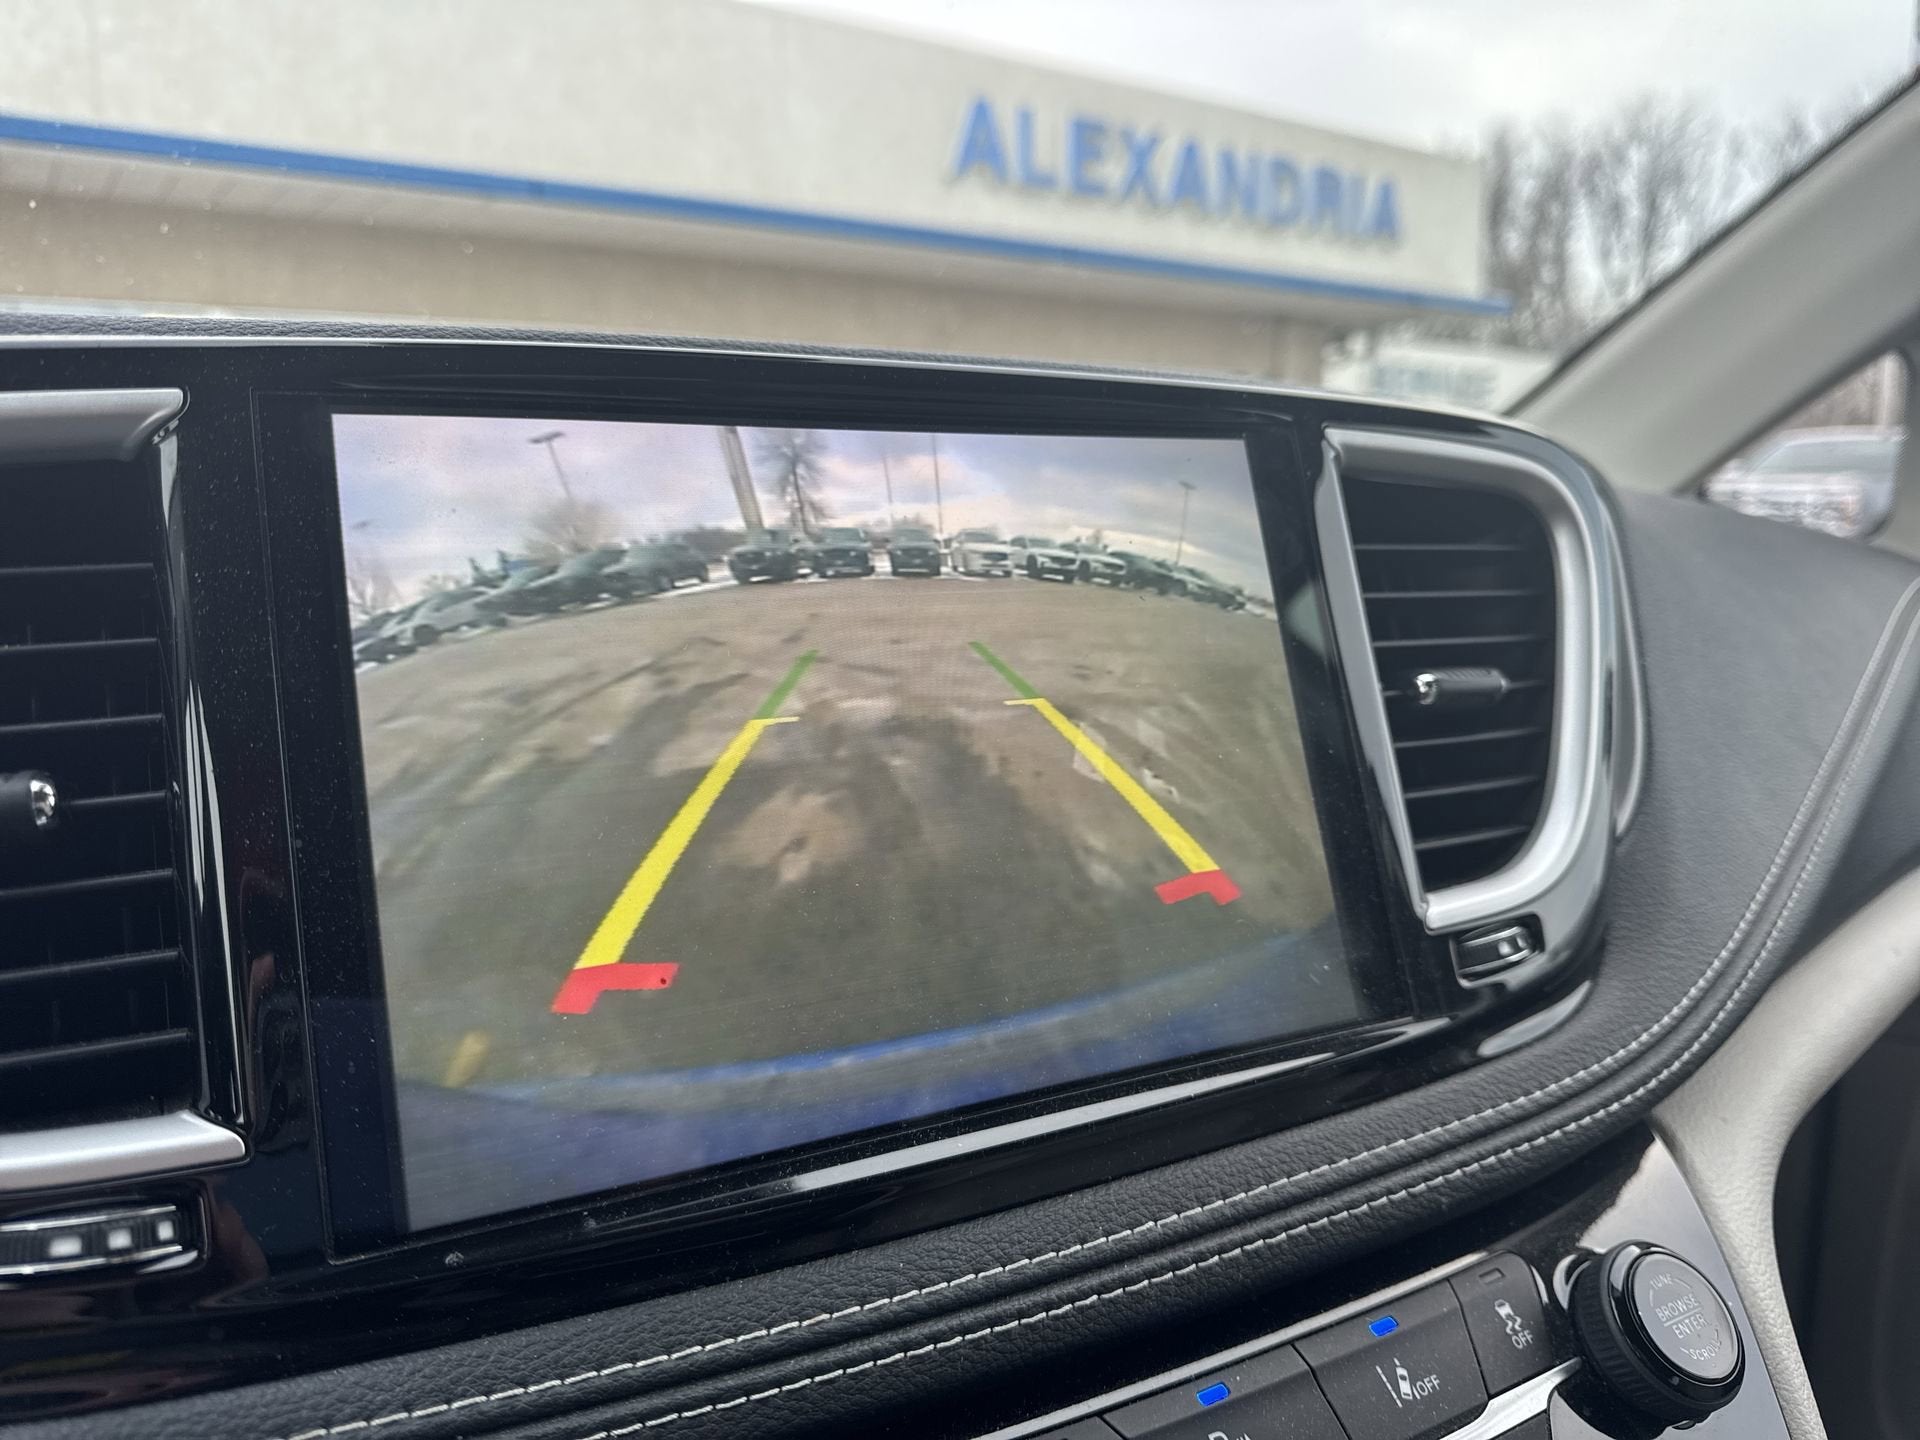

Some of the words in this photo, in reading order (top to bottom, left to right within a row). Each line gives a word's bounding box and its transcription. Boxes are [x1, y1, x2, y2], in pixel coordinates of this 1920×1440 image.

[953, 96, 1401, 240] ALEXANDRIA
[1649, 1273, 1672, 1290] TUNE
[1655, 1293, 1700, 1322] BROWSE
[1672, 1313, 1709, 1339] ENTER
[1511, 1330, 1534, 1349] OFF
[1689, 1339, 1721, 1361] SCROLL
[1416, 1374, 1441, 1396] OFF
